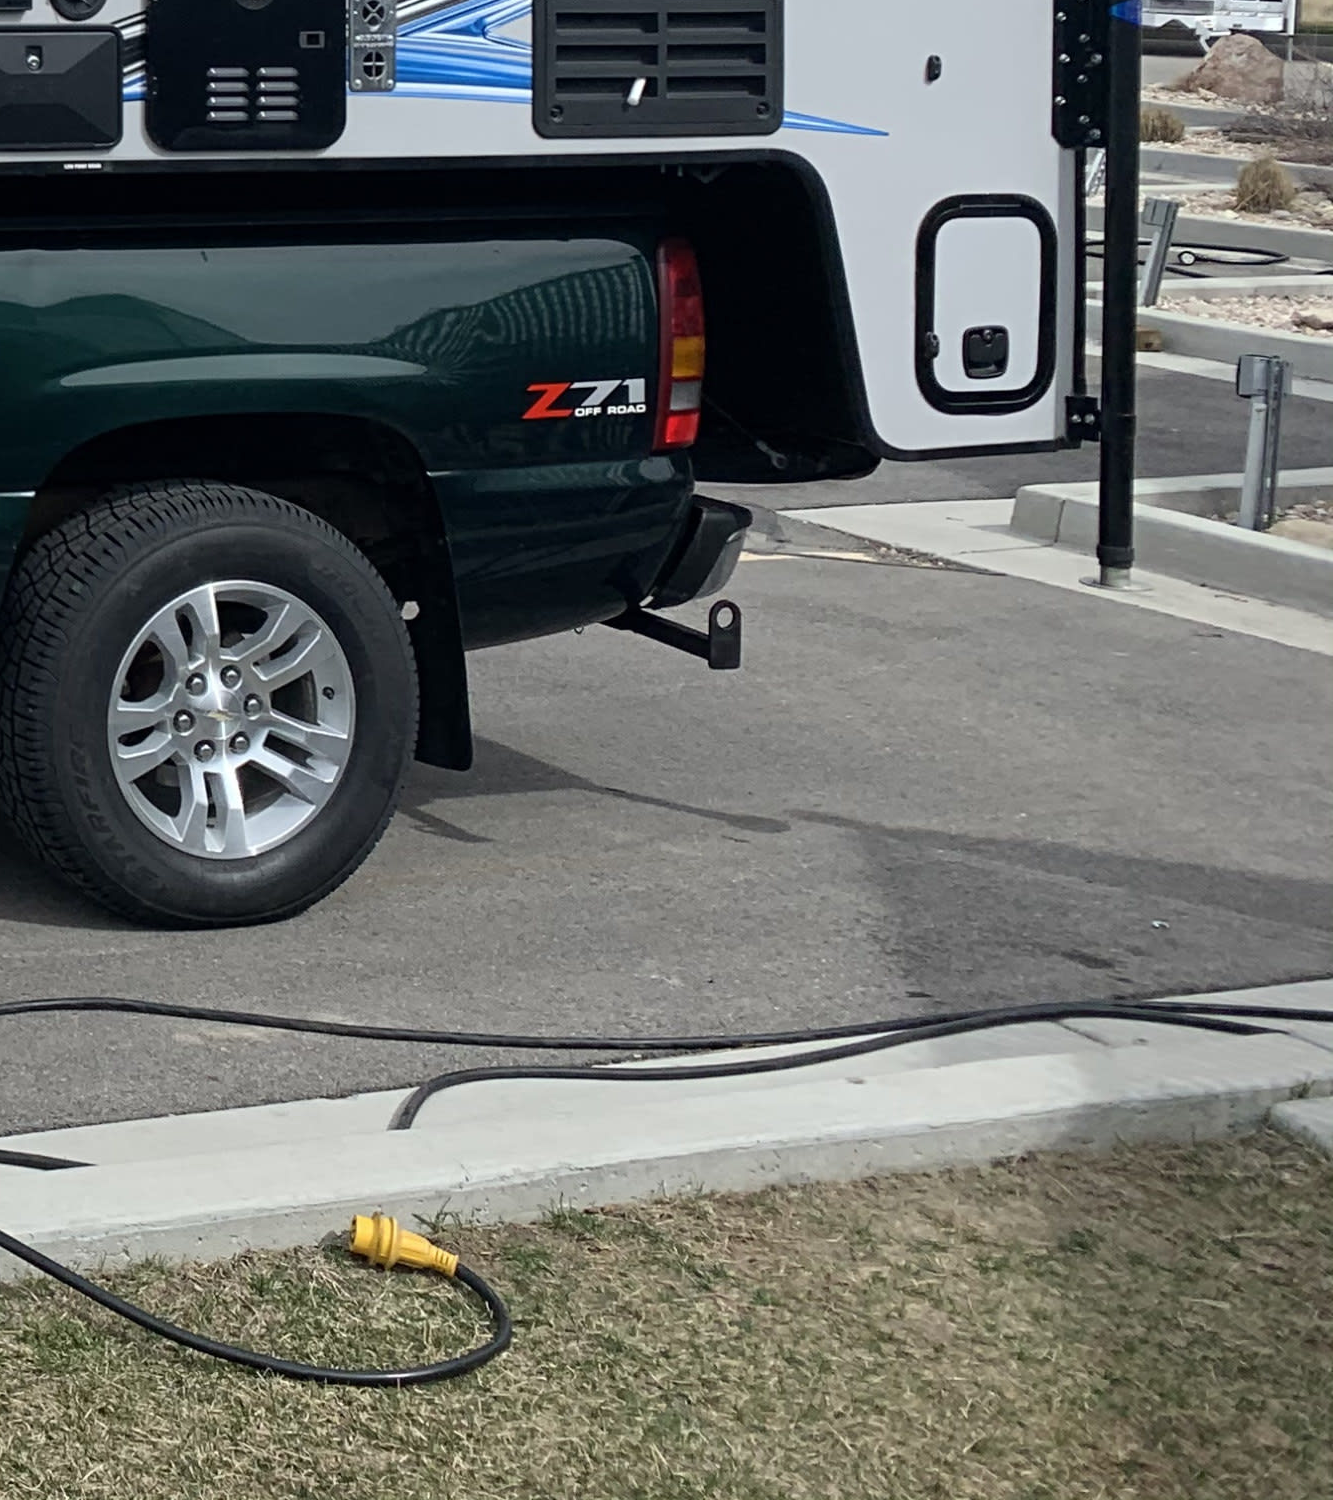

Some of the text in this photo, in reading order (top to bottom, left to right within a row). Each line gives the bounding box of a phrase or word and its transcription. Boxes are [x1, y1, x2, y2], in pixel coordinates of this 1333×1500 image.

[521, 378, 646, 419] Z71
[574, 403, 647, 418] OFF ROAD
